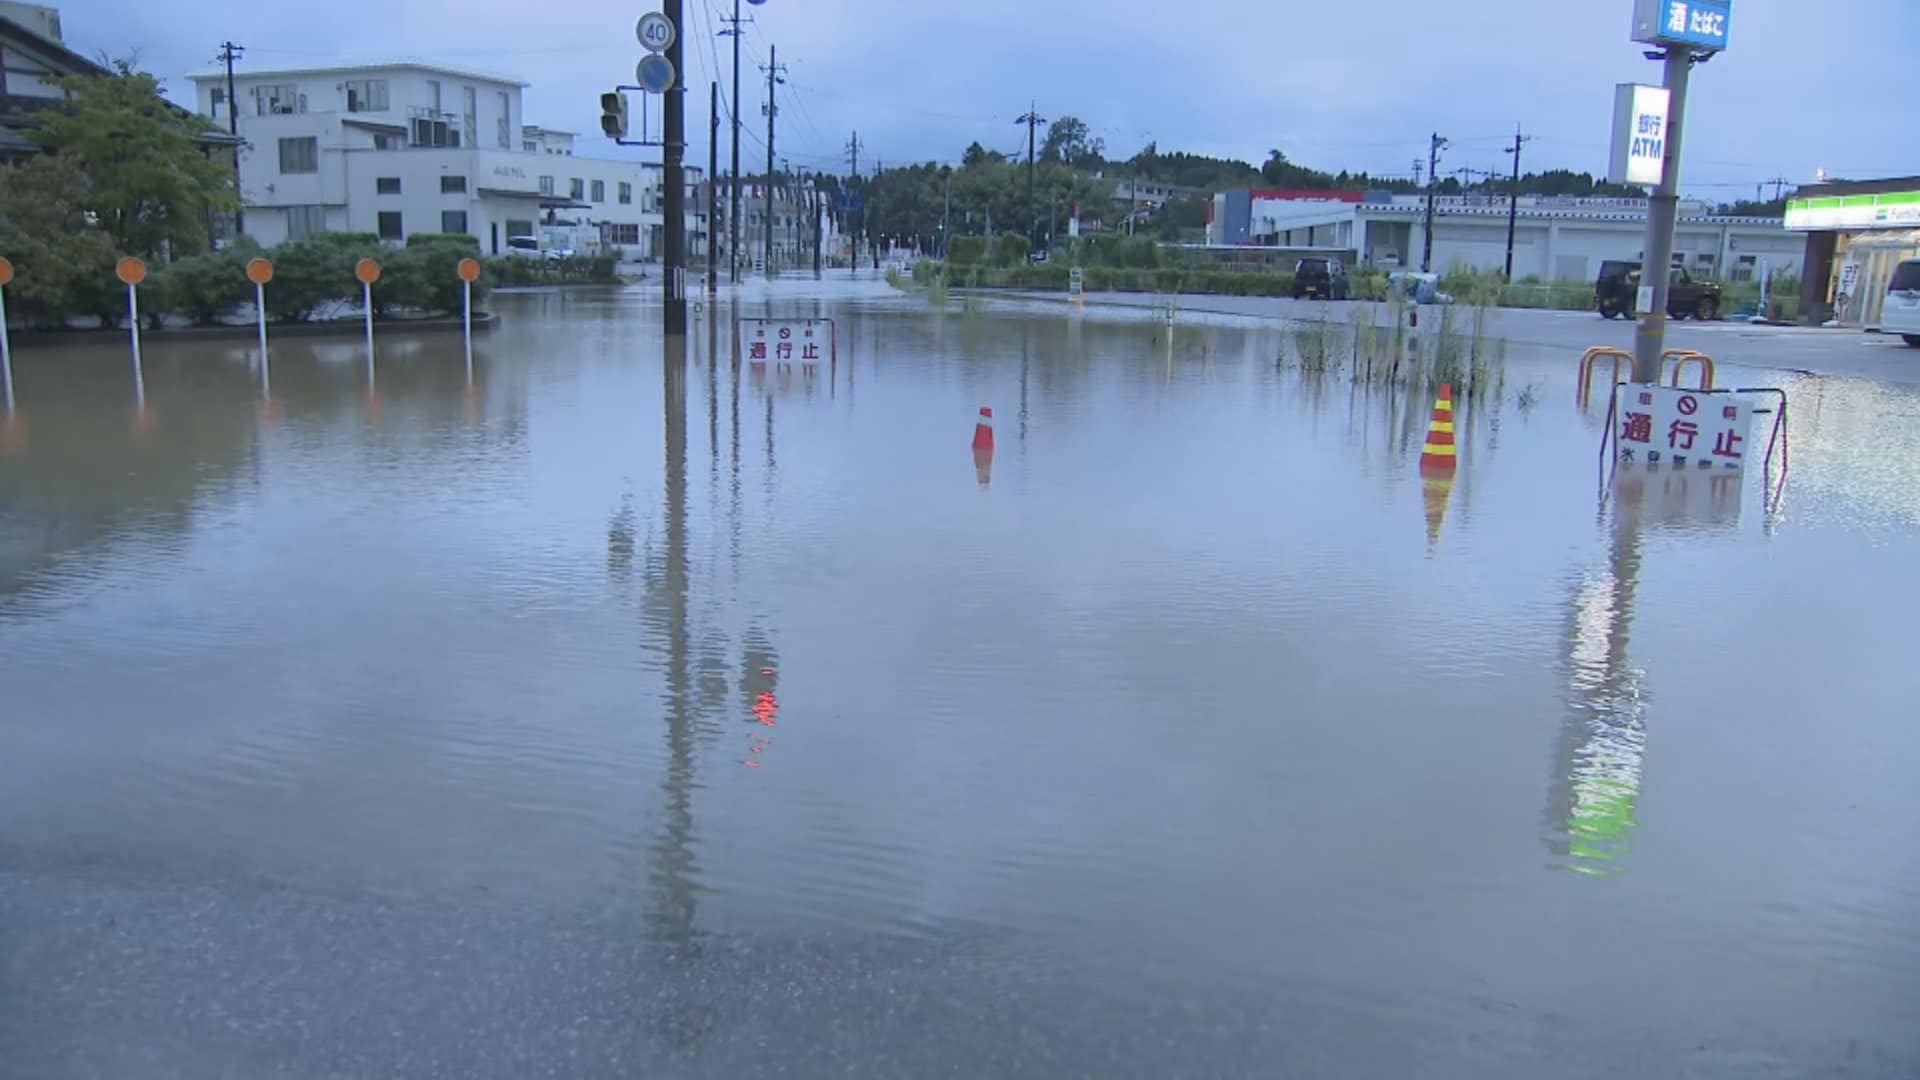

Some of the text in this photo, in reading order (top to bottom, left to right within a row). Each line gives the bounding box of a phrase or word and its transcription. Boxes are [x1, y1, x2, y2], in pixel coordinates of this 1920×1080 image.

[1667, 1, 1724, 36] 酒 たばこ
[646, 23, 667, 41] 40
[1631, 136, 1662, 159] ATM
[750, 342, 819, 359] 通行止
[1620, 411, 1743, 459] 通行止
